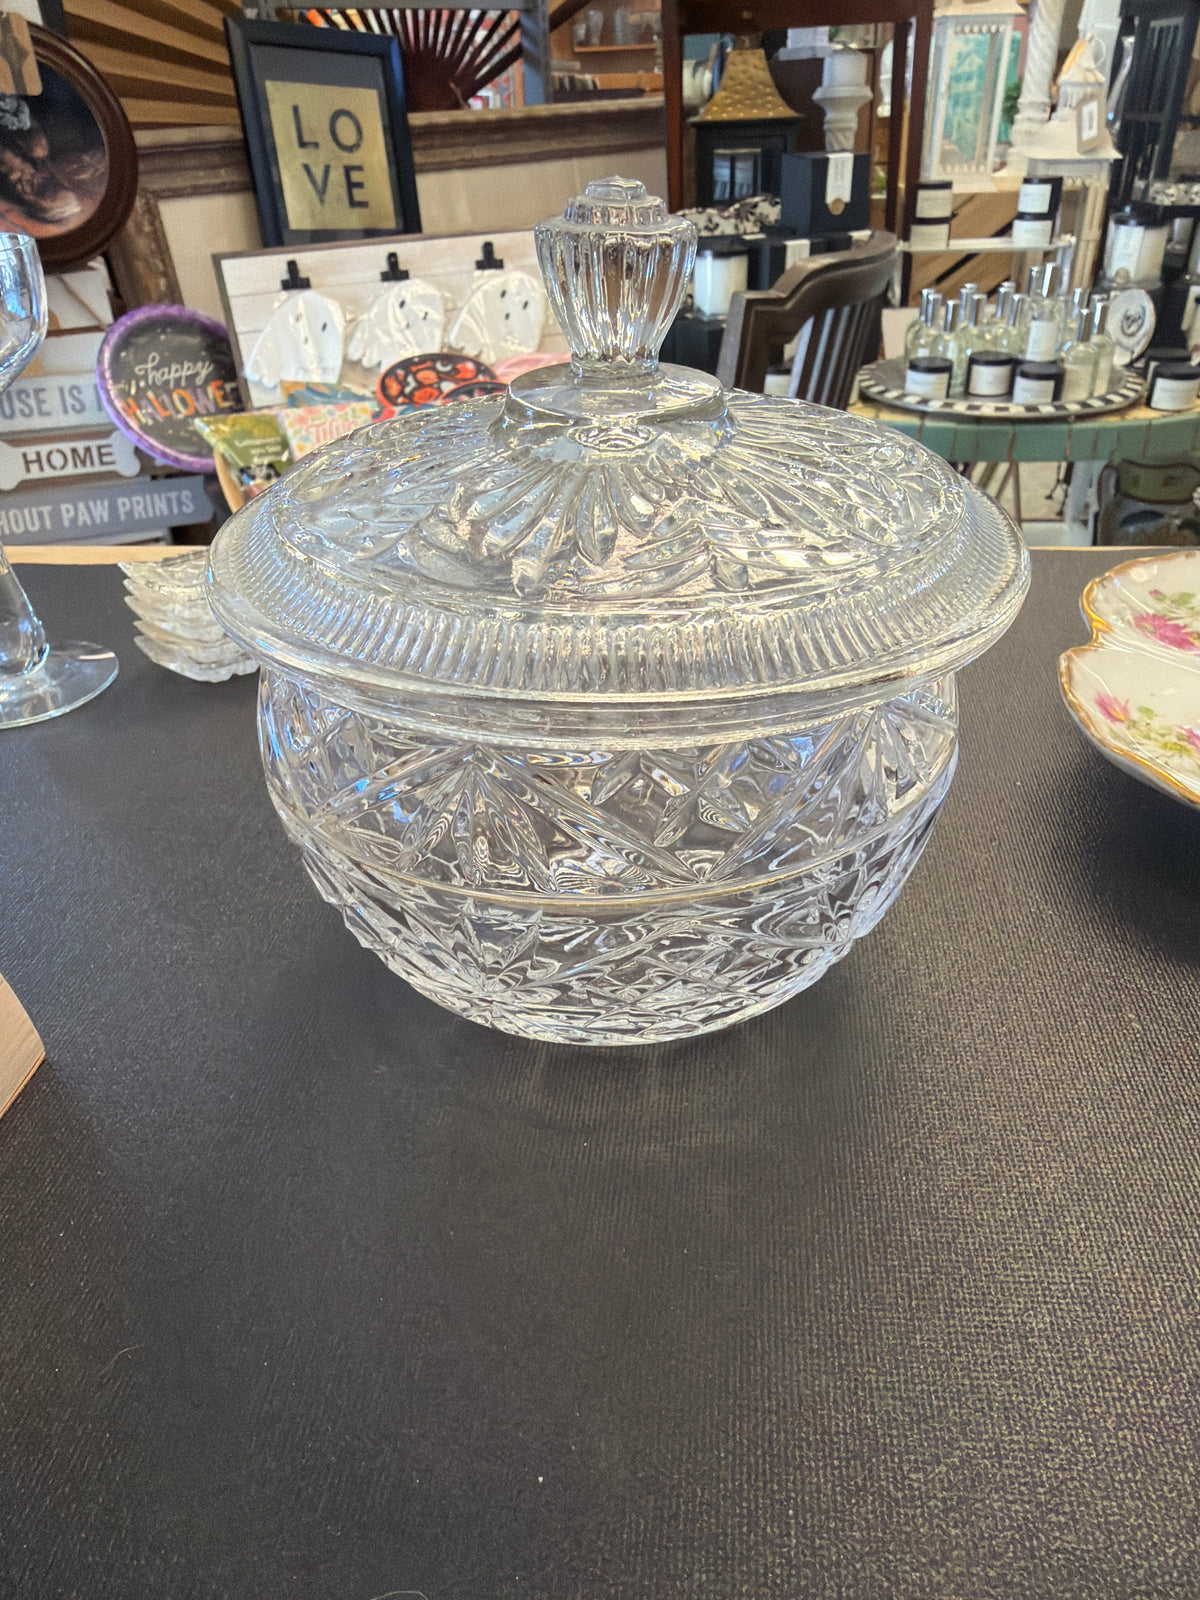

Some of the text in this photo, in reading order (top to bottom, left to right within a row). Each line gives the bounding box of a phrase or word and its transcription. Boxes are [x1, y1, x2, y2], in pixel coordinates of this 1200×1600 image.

[134, 352, 214, 389] happy
[58, 384, 86, 415] IS
[22, 443, 116, 474] HOME
[60, 497, 110, 528] PAW
[117, 490, 195, 520] PRINTS
